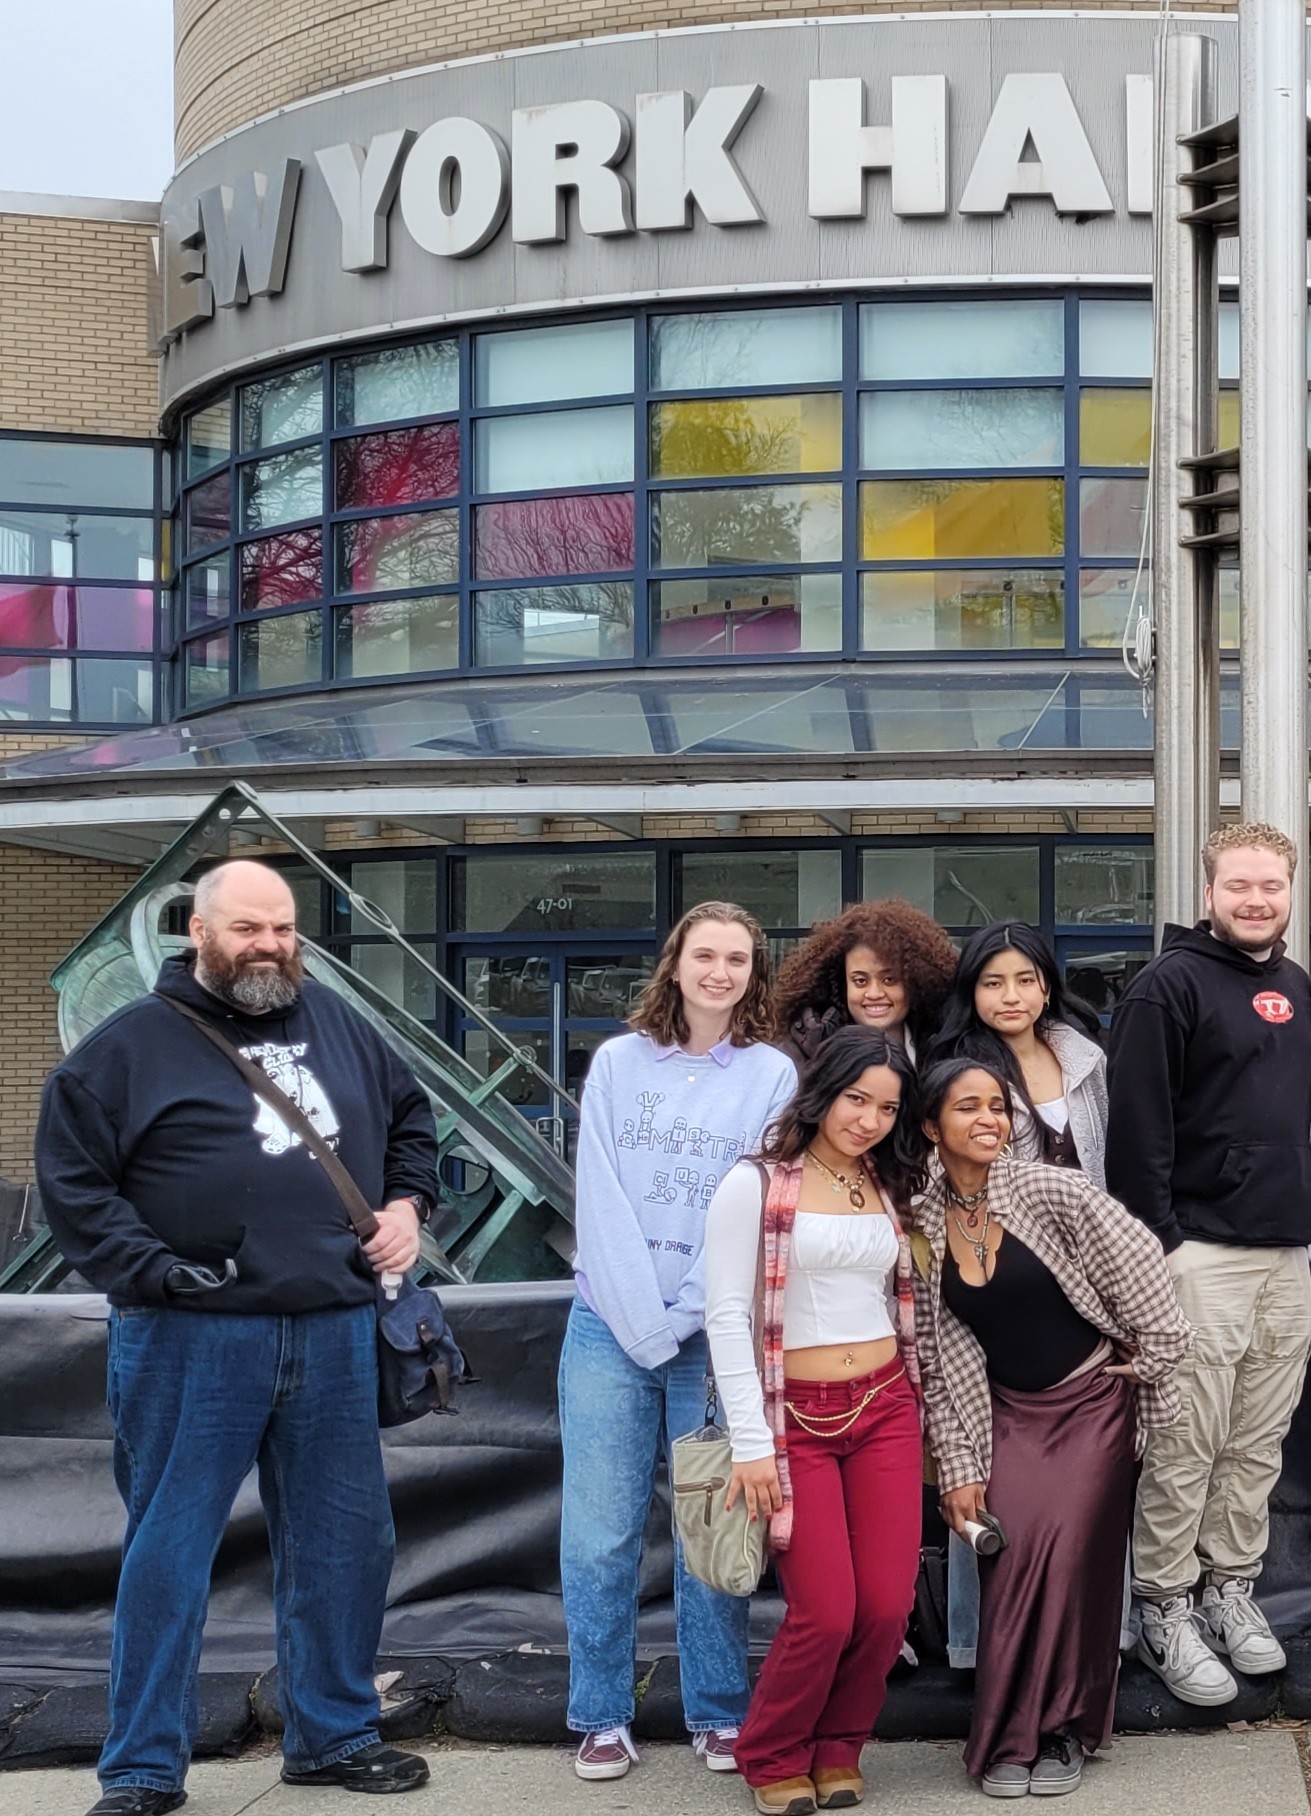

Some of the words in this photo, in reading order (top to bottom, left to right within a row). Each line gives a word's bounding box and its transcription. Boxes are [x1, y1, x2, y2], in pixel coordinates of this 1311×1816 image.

[148, 158, 302, 357] EW
[314, 83, 767, 275] YORK
[536, 897, 573, 915] 47-01
